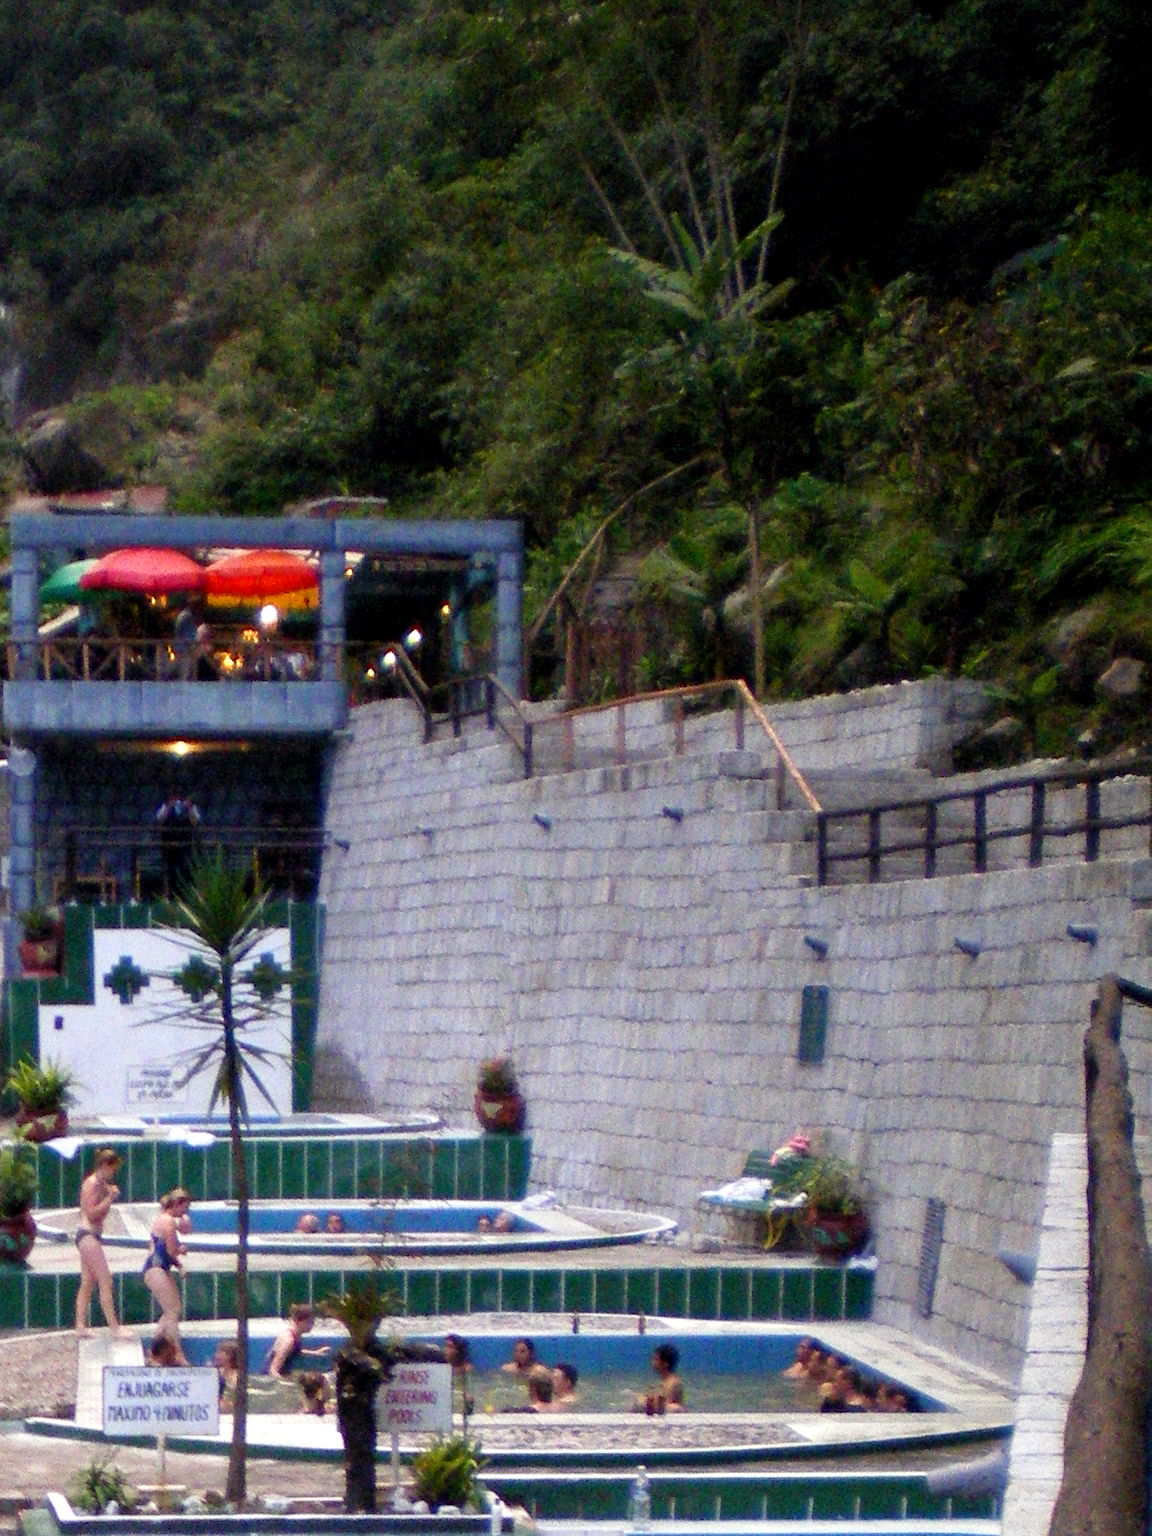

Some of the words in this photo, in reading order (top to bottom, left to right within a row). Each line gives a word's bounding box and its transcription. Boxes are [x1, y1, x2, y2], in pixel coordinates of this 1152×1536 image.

[117, 1380, 192, 1398] ENJUAGARSE
[108, 1405, 151, 1422] MAXIMO
[163, 1404, 210, 1422] MINUTOS
